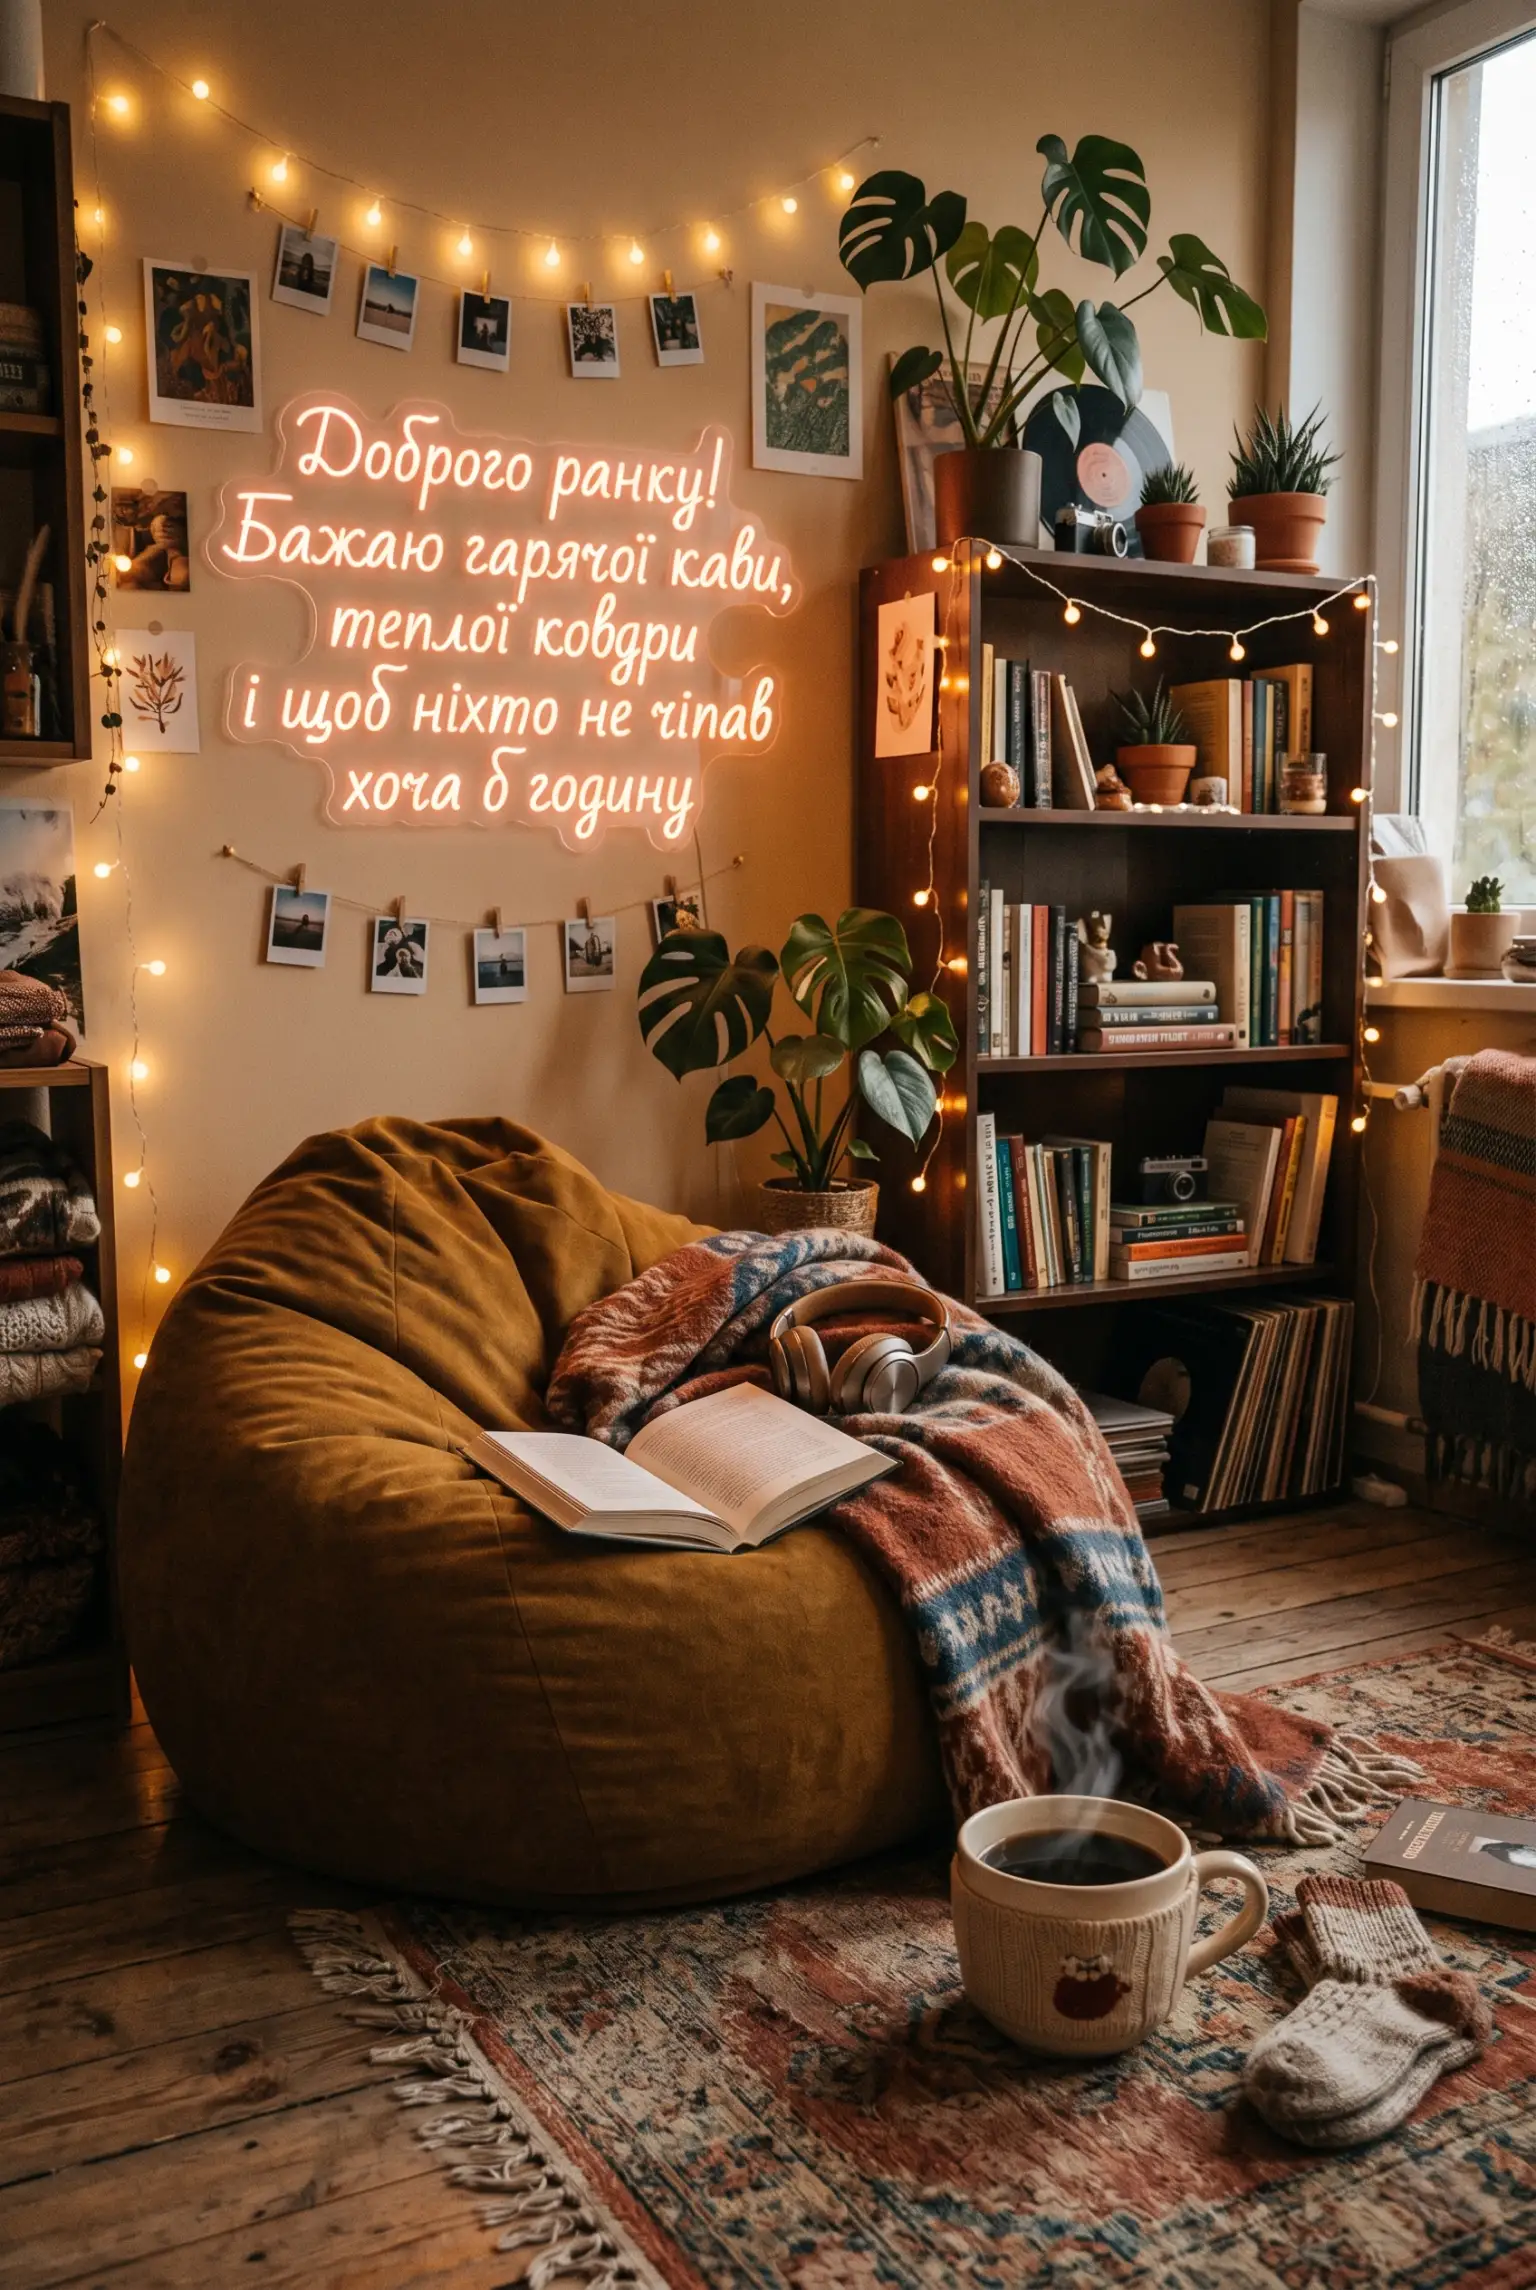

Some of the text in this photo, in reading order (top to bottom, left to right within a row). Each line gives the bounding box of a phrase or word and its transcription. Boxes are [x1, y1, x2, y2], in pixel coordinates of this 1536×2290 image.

[297, 406, 723, 531] Доброго ранку!
[222, 492, 792, 605] Бажаю гарячої кави,
[331, 592, 698, 686] теплої ковдри
[244, 663, 774, 744] і щоб ніхто не чіпав
[342, 746, 694, 839] хоча б годину
